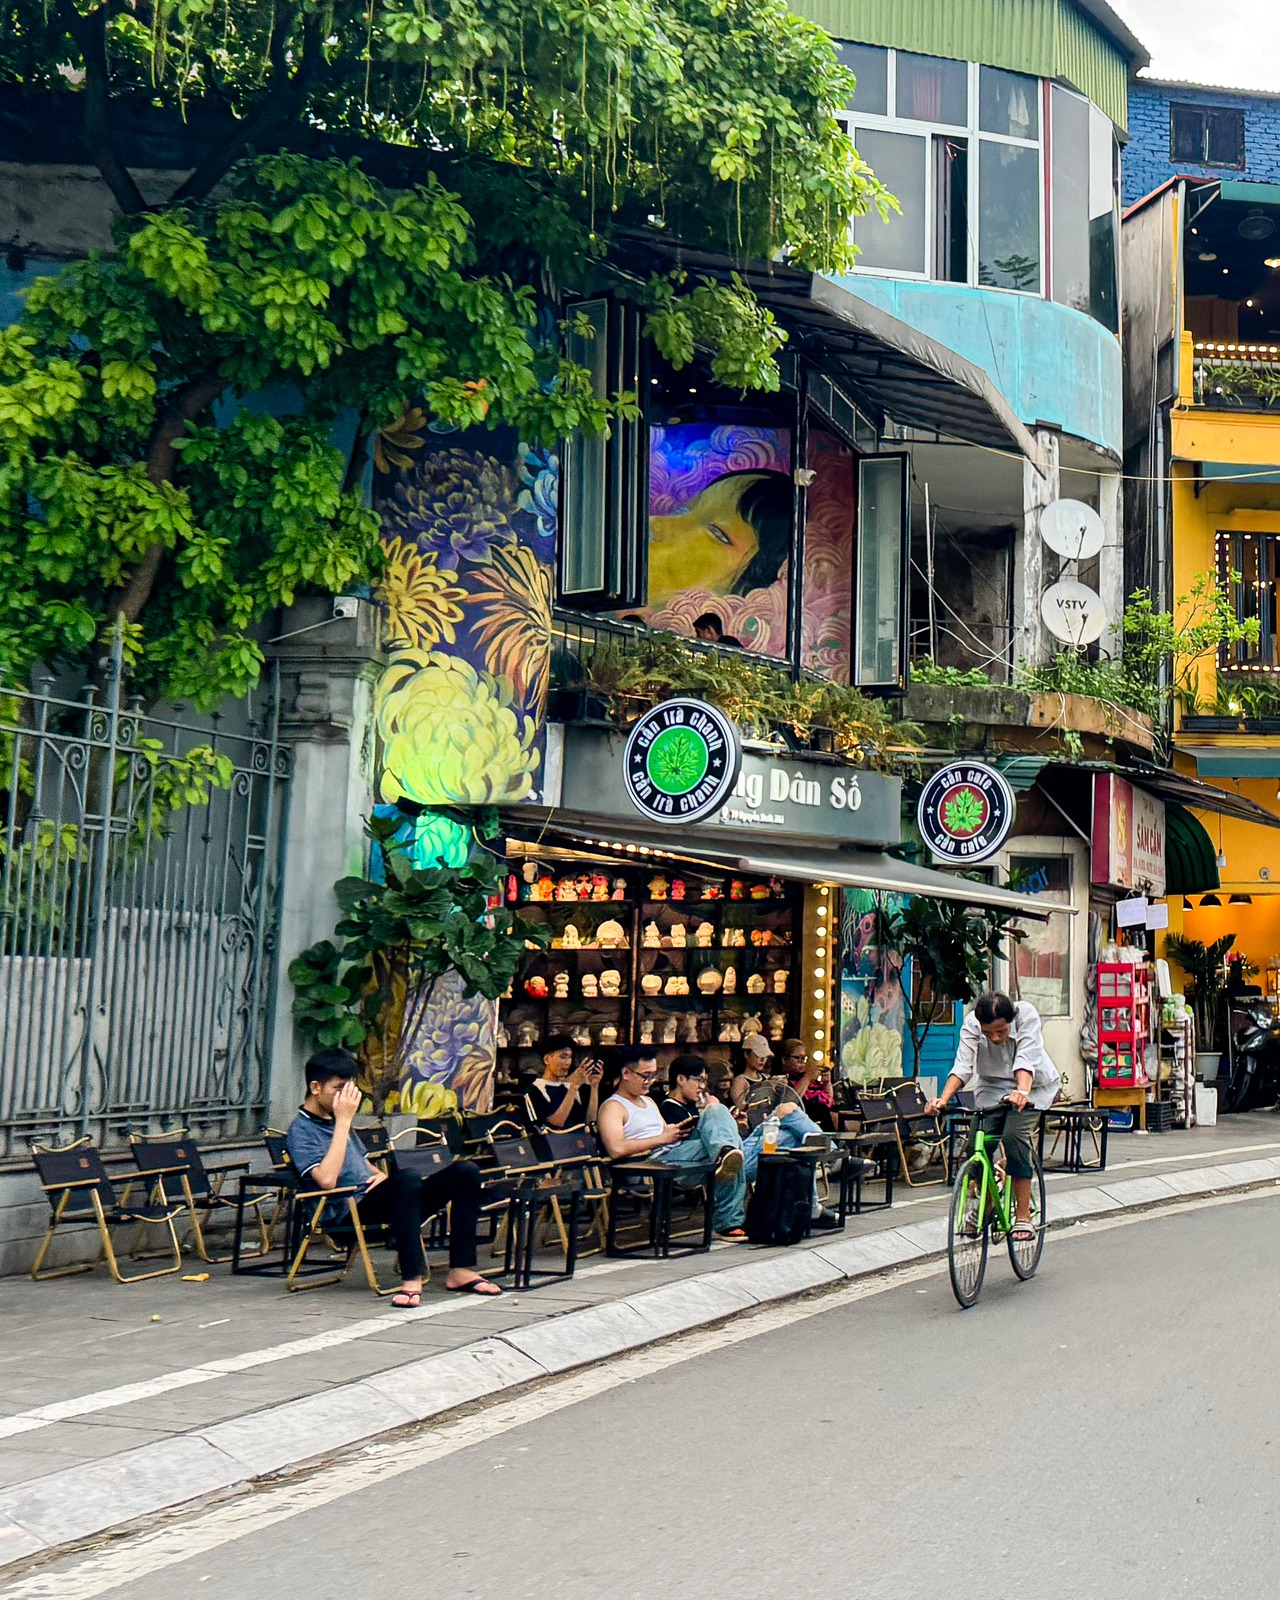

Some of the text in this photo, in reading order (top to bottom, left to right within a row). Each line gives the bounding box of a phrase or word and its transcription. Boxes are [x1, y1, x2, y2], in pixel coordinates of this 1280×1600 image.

[1056, 599, 1088, 610] VSTV
[689, 712, 724, 752] chanh
[680, 775, 720, 812] chanh
[731, 768, 862, 811] ng Dân Số
